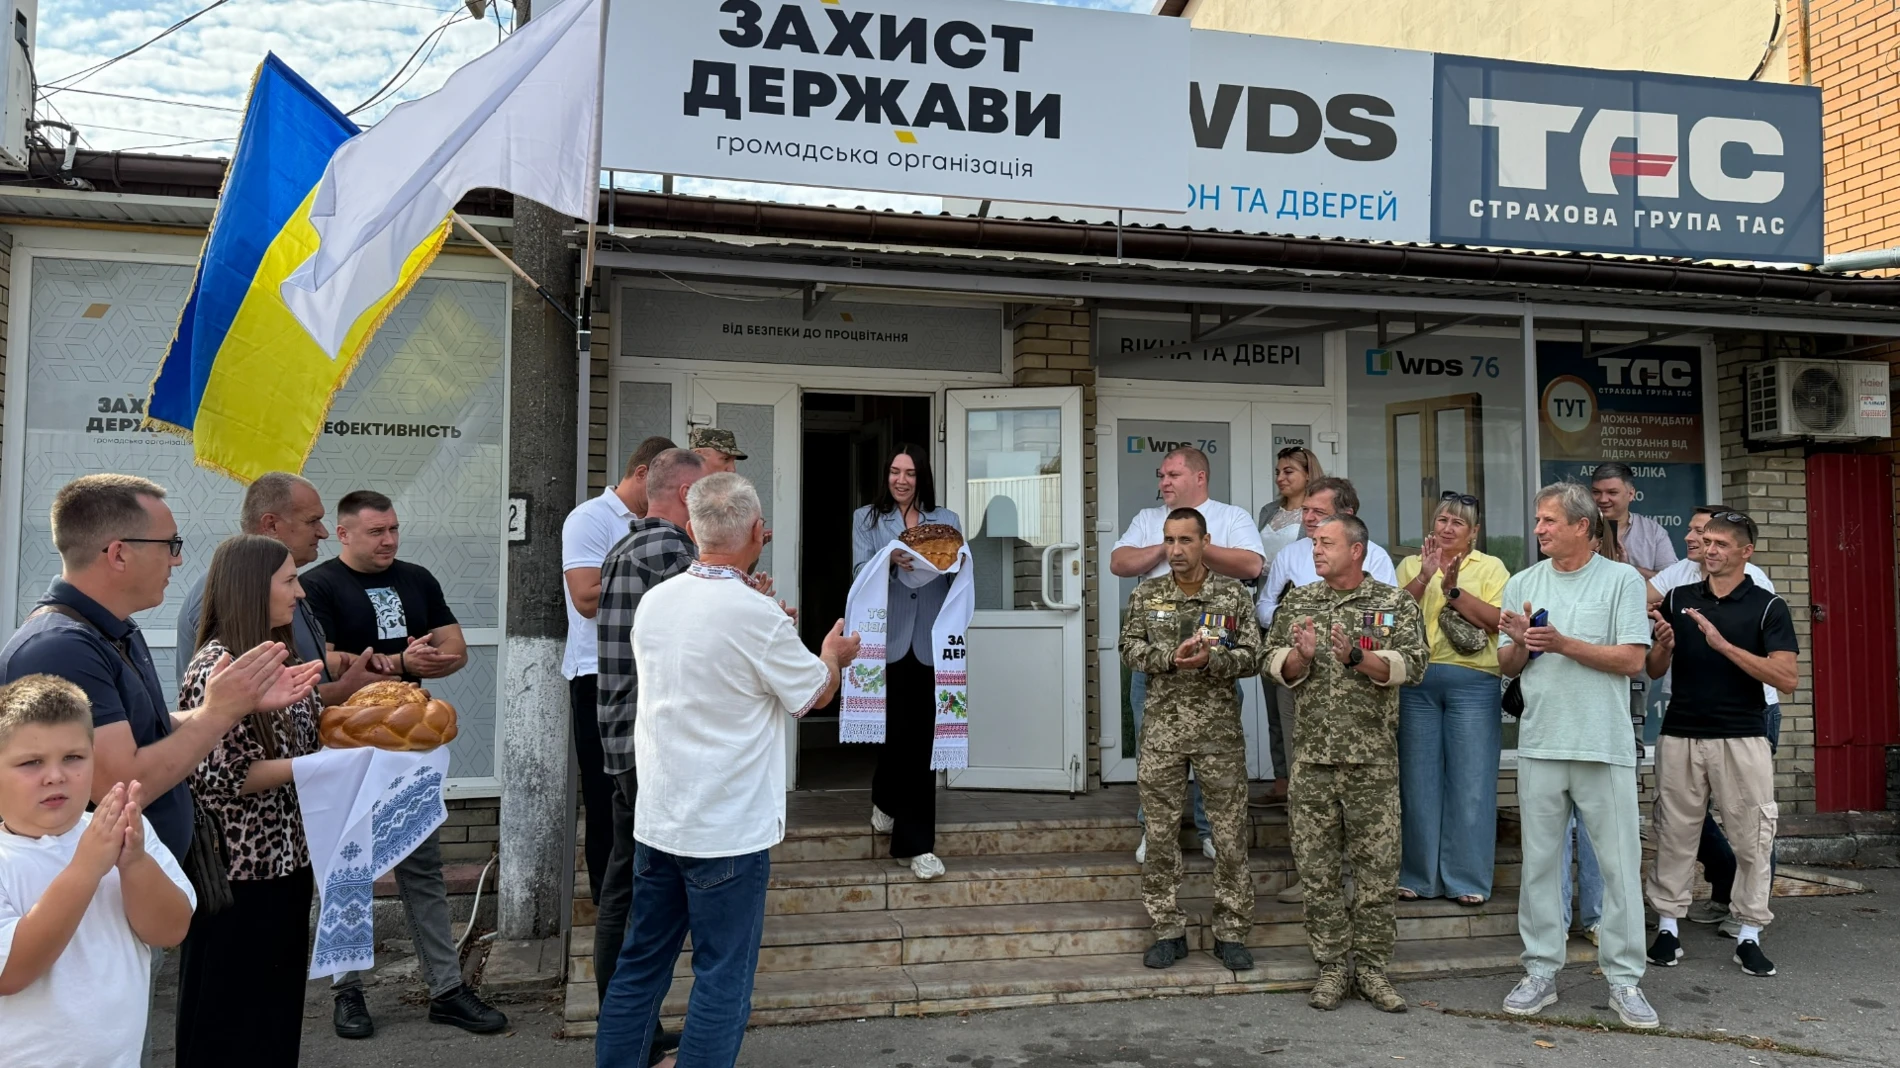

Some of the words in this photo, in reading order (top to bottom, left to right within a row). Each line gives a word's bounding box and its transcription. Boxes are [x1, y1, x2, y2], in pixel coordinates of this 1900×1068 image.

[718, 0, 1035, 73] ЗАХИСТ
[683, 59, 1062, 140] ДЕРЖАВИ
[716, 134, 879, 164] громадська
[887, 149, 1034, 179] організація
[1230, 186, 1269, 215] ТА
[1276, 190, 1398, 222] ДВЕРЕЙ
[1468, 199, 1618, 227] СТРАХОВА
[1633, 210, 1722, 232] ГРУПА
[1736, 215, 1785, 235] ТАС
[722, 322, 743, 336] ВІД
[747, 325, 800, 338] БЕЗПЕКИ
[803, 328, 822, 339] ДО
[825, 328, 909, 343] ПРОЦВІТАННЯ
[1233, 343, 1300, 366] ДВЕРІ
[1396, 350, 1464, 377] WDS
[1470, 355, 1500, 379] 76
[1598, 387, 1643, 396] СТРАХОВА
[1646, 388, 1673, 397] ГРУПА
[1677, 389, 1692, 398] ТАС
[1860, 378, 1884, 388] Haier
[1553, 398, 1586, 418] ТУТ
[324, 420, 462, 438] ЕФЕКТИВНІСТЬ
[1600, 414, 1640, 425] МОЖНА
[1641, 415, 1694, 427] ПРИДБАТИ
[1283, 436, 1304, 445] WDS
[1600, 426, 1642, 437] ДОГОВІР
[1197, 439, 1217, 454] 76
[1601, 438, 1669, 448] СТРАХУВАННЯ
[1672, 439, 1688, 449] ВІД
[1602, 449, 1636, 460] ЛІДЕРА
[1638, 450, 1670, 460] РИНКУ
